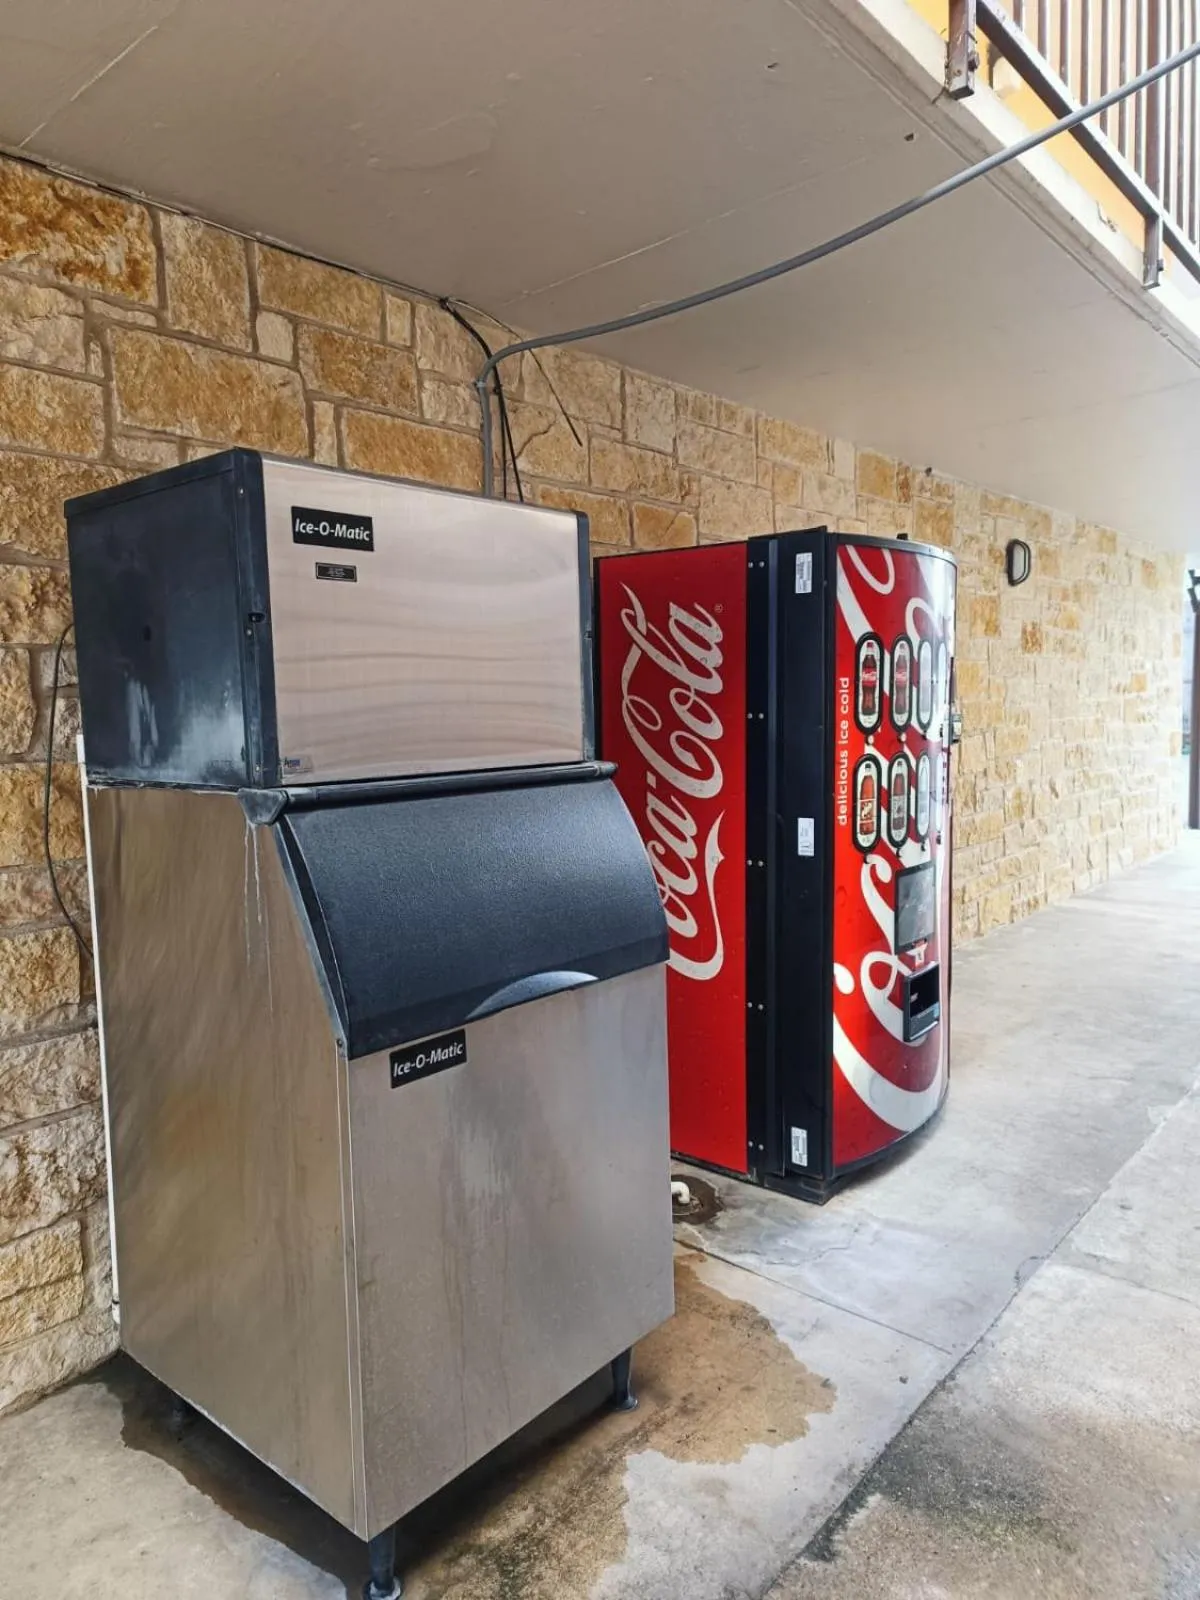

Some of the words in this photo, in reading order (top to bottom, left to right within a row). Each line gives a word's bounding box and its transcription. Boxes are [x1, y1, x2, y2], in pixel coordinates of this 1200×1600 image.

[295, 518, 371, 541] Ice-O-Matic
[838, 677, 850, 715] cold
[837, 719, 849, 745] ice
[837, 749, 849, 826] delicious
[393, 1042, 464, 1078] Ice-O-Matic
